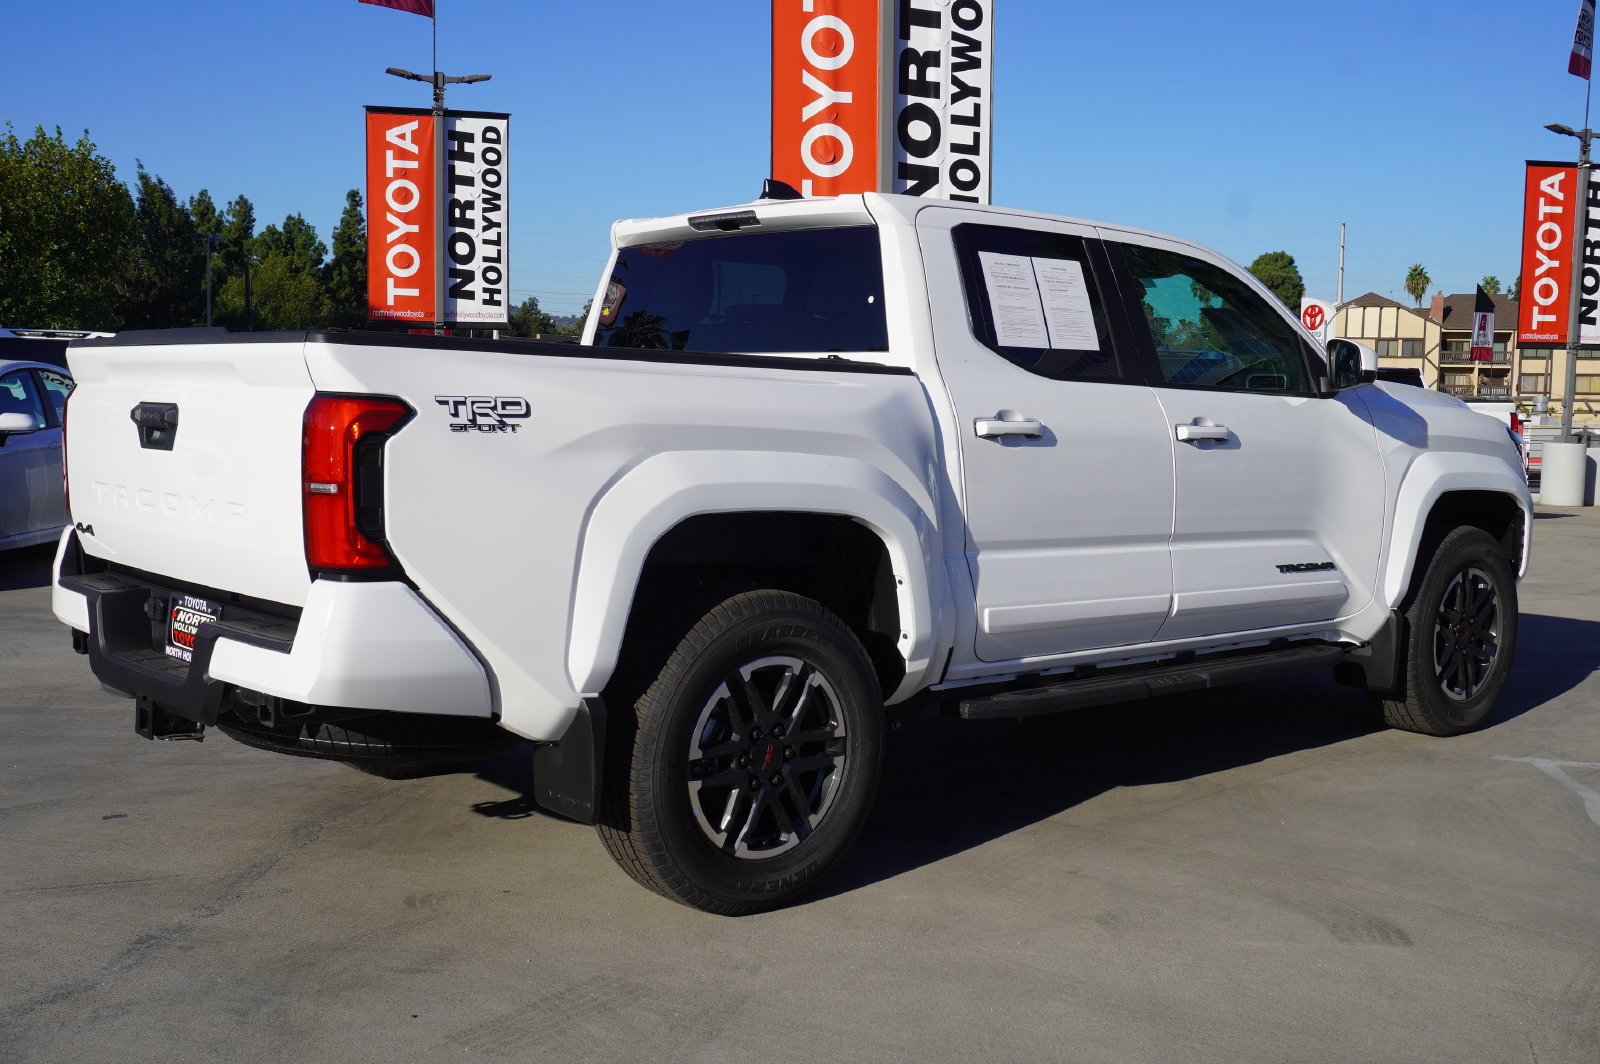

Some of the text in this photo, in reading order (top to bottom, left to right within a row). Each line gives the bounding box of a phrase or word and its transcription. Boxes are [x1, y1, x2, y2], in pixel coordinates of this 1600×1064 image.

[385, 119, 420, 306] TOYOTA
[448, 129, 476, 301] NORTH
[481, 125, 502, 307] HOLLYWOOD
[1532, 171, 1566, 330] TOYOTA
[435, 395, 532, 425] TRD
[449, 423, 522, 434] SPORT
[92, 481, 248, 526] TACOMA
[184, 595, 207, 612] TOYOTA
